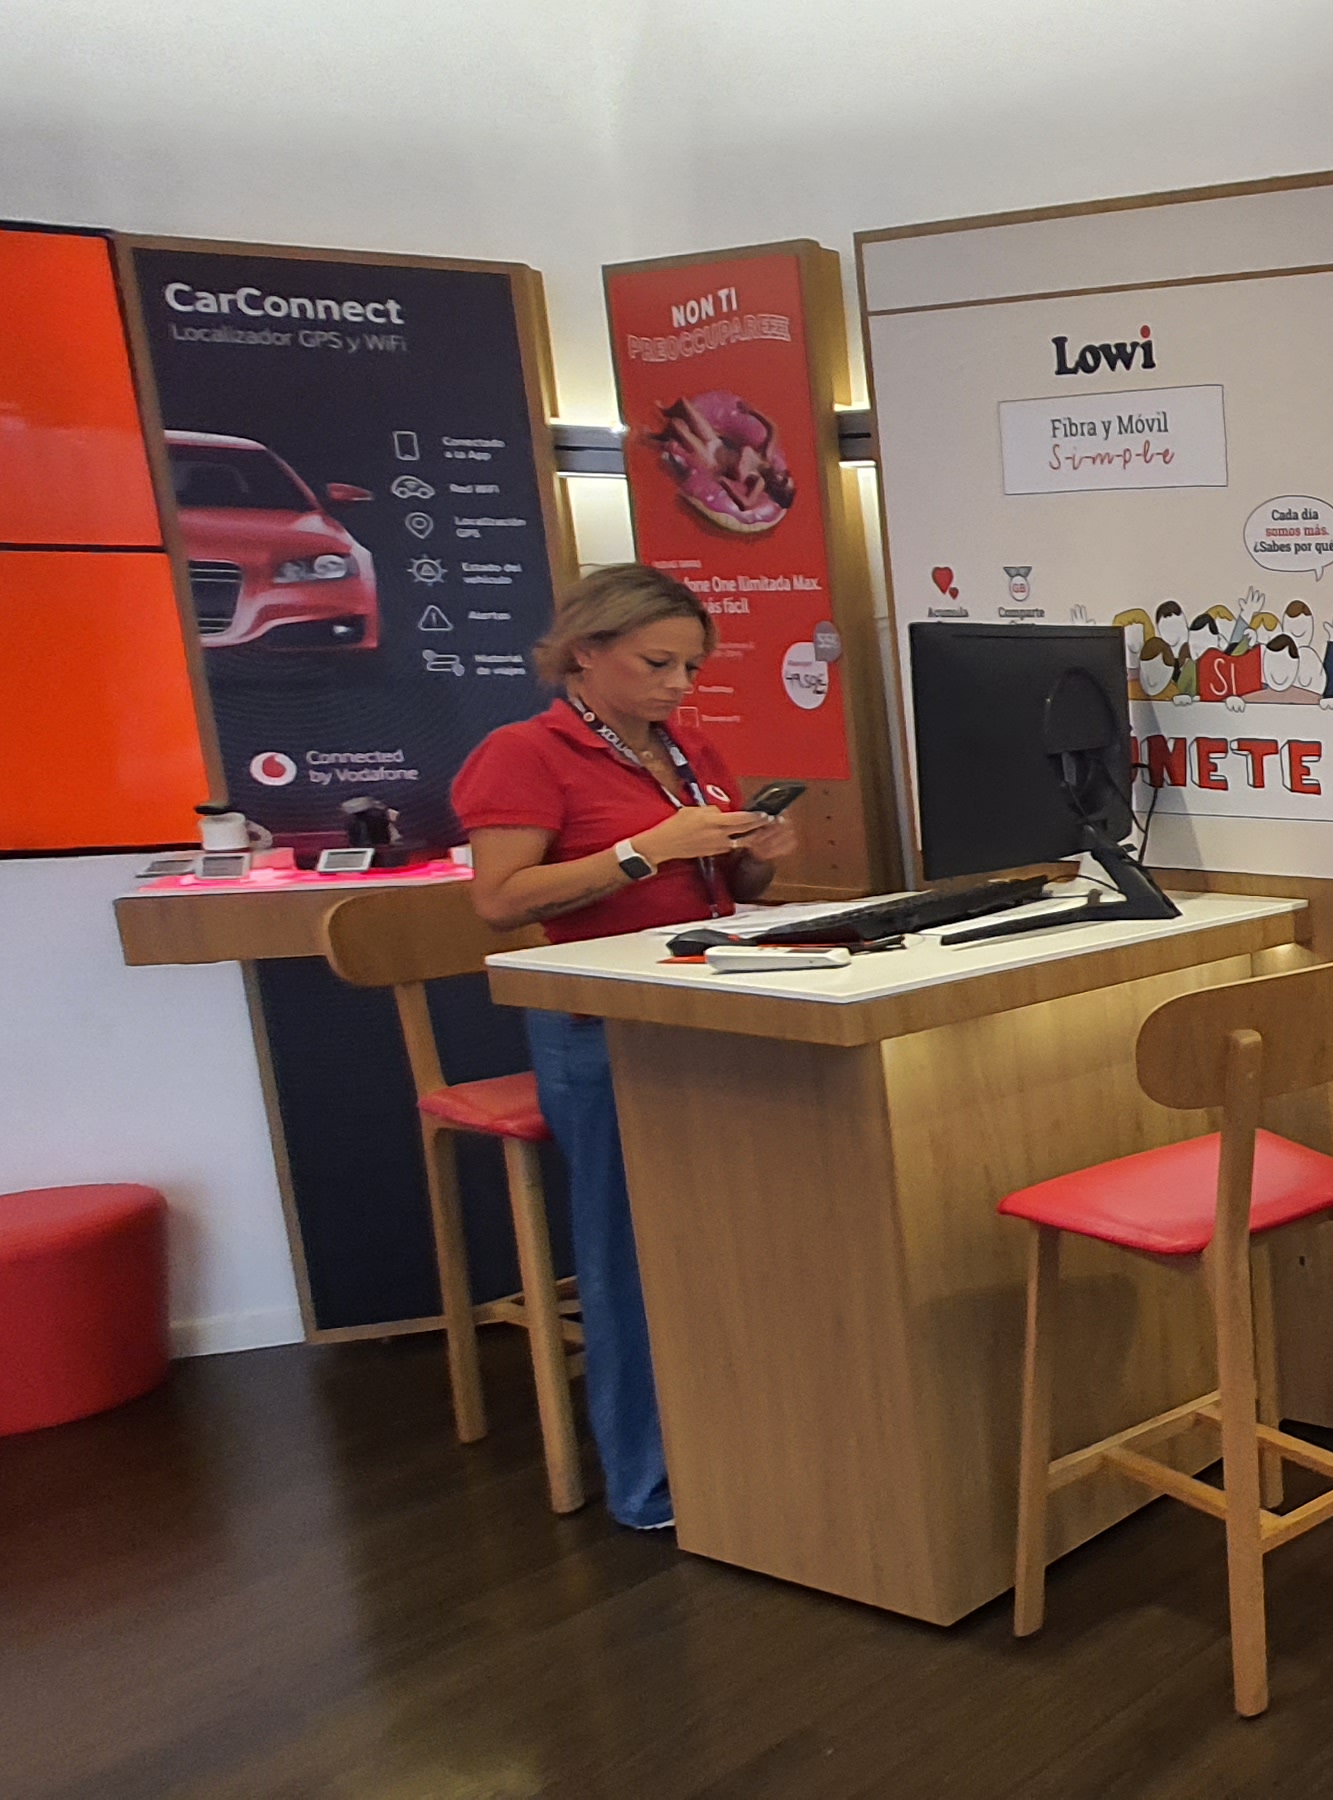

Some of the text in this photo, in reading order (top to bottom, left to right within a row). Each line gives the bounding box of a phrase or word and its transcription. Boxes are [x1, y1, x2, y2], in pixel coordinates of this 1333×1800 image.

[164, 282, 404, 324] CarConnect
[670, 286, 739, 329] NON TI
[169, 322, 407, 352] Localizador GPS y WiFi
[1051, 324, 1157, 376] Lowi
[1050, 411, 1170, 441] Fibra y Móvil
[1271, 508, 1320, 522] Cada día
[1265, 523, 1330, 538] somos más.
[1253, 540, 1292, 554] ¿Sabes
[1294, 542, 1312, 555] por
[306, 748, 405, 765] Connected
[308, 766, 420, 786] by Vodafone
